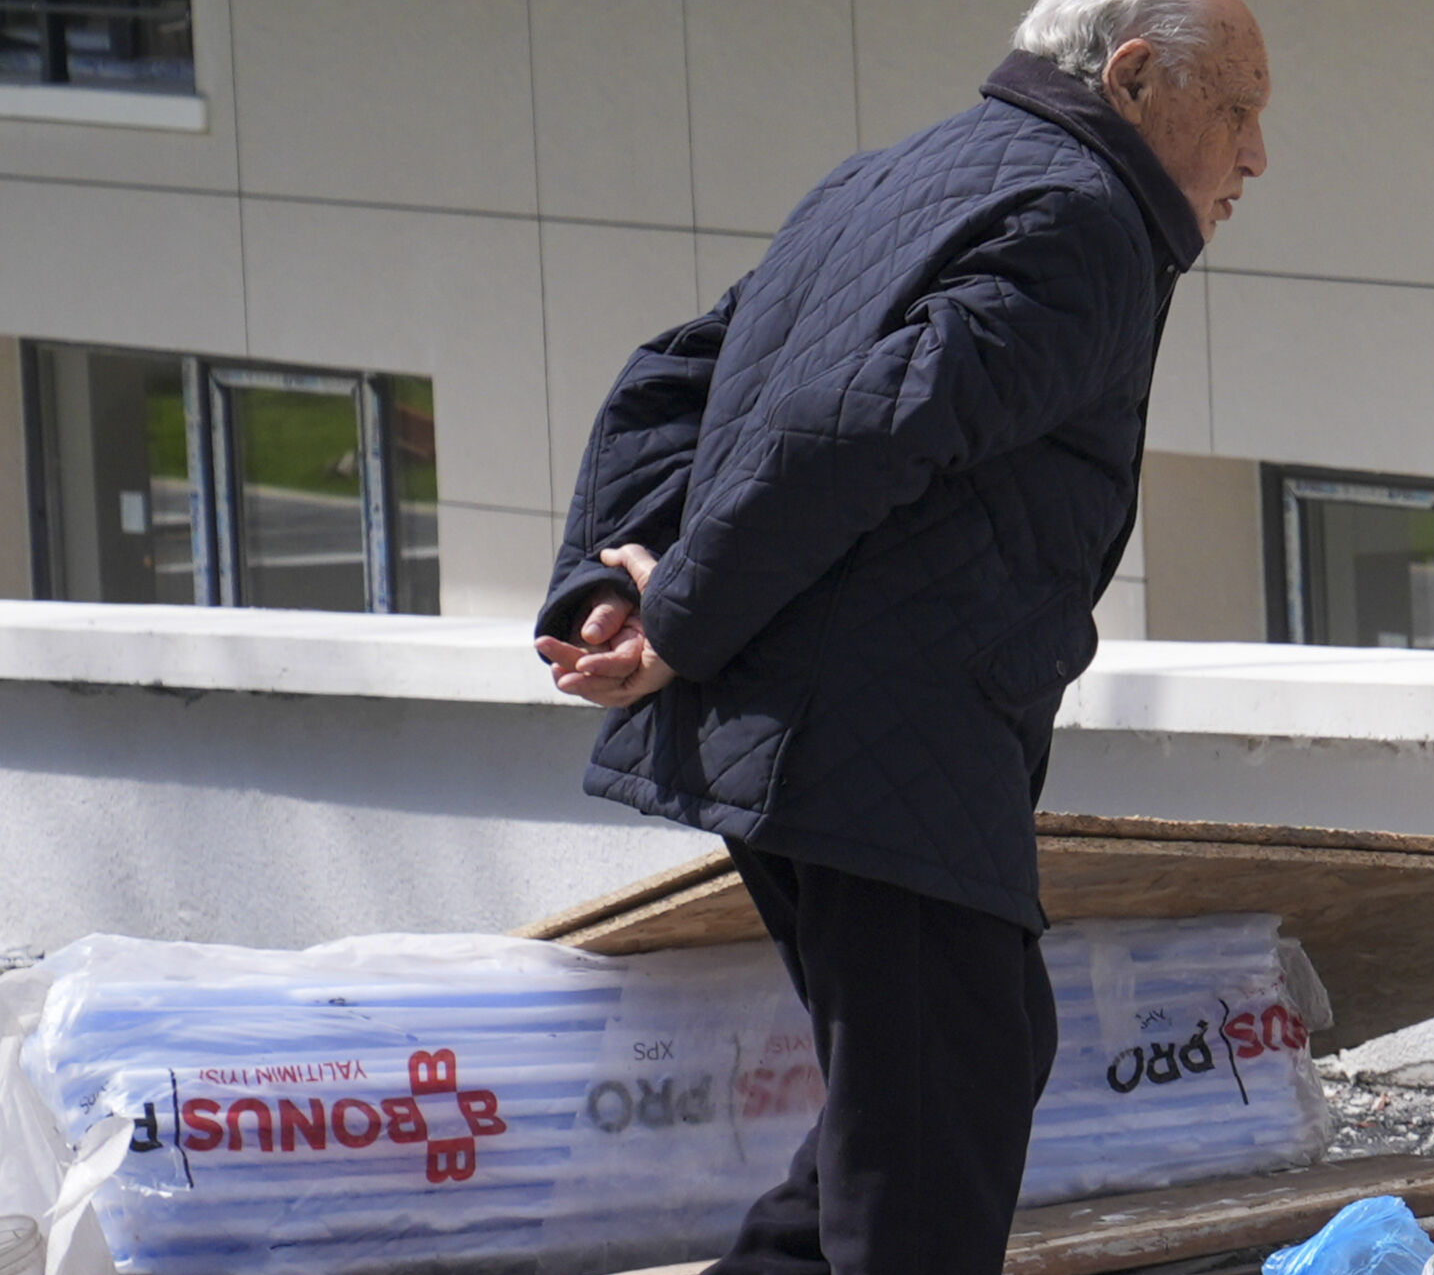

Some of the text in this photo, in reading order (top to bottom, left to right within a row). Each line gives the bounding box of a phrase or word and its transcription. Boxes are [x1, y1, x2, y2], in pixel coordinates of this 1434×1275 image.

[634, 1039, 675, 1061] XPS
[180, 1093, 428, 1154] BONUS
[586, 1076, 715, 1133] PRO
